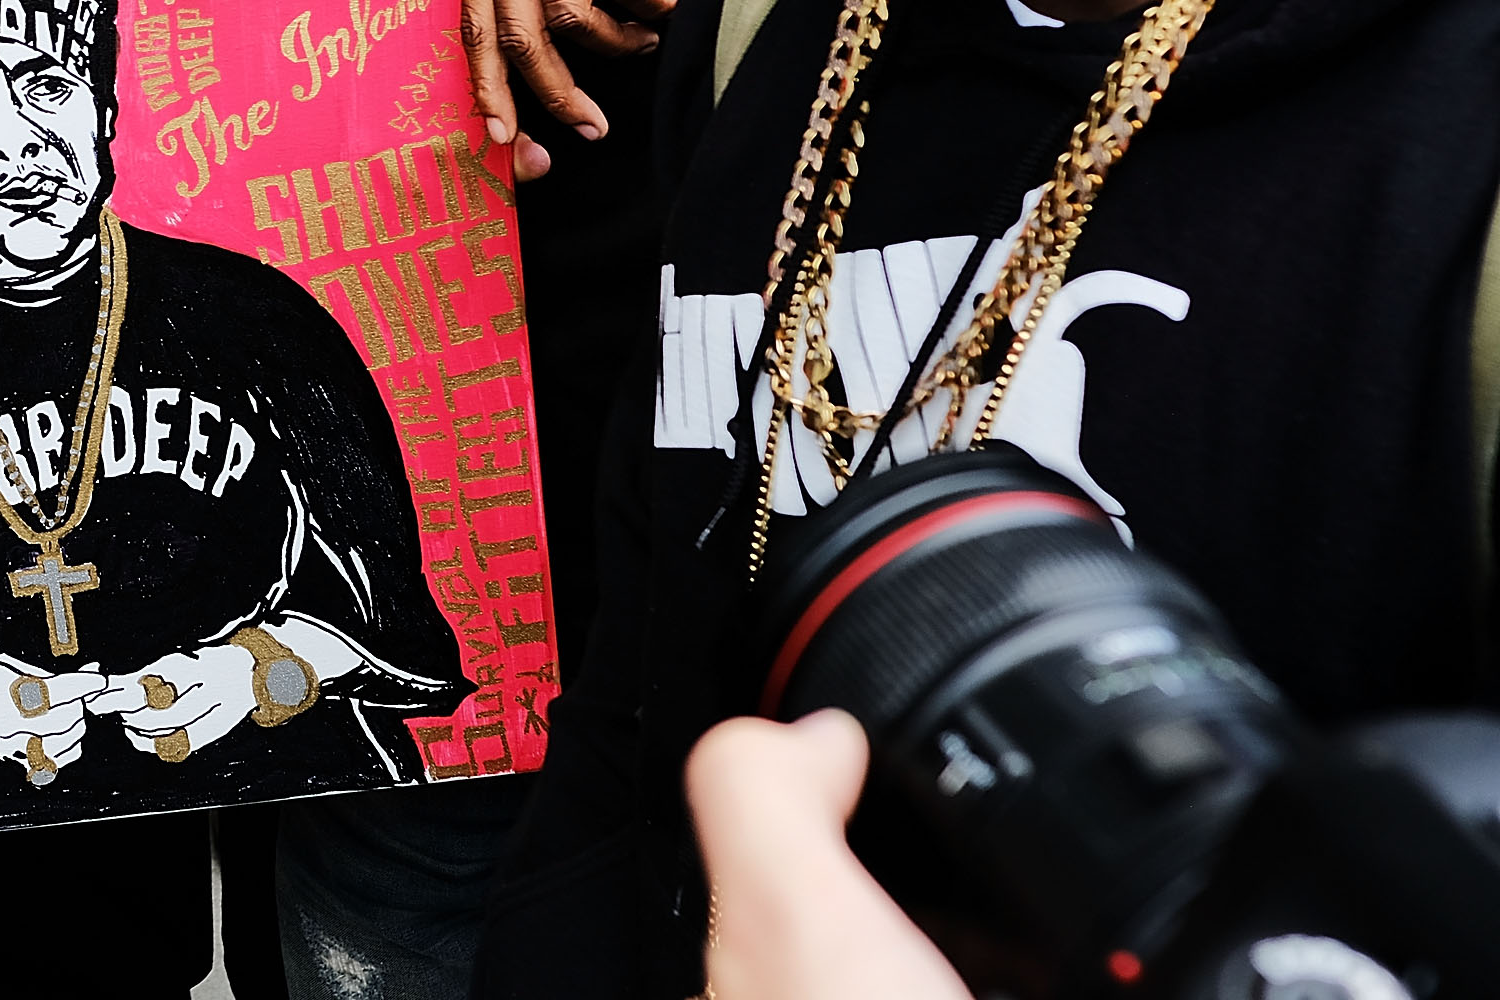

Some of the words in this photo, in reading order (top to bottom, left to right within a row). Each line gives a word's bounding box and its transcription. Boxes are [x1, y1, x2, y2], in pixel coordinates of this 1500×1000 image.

[176, 7, 222, 94] DEEP
[156, 95, 280, 200] The
[245, 129, 516, 269] SHOOK
[307, 218, 527, 372] ONES
[101, 385, 256, 498] DEEP
[387, 371, 447, 457] THE
[410, 469, 457, 533] OF
